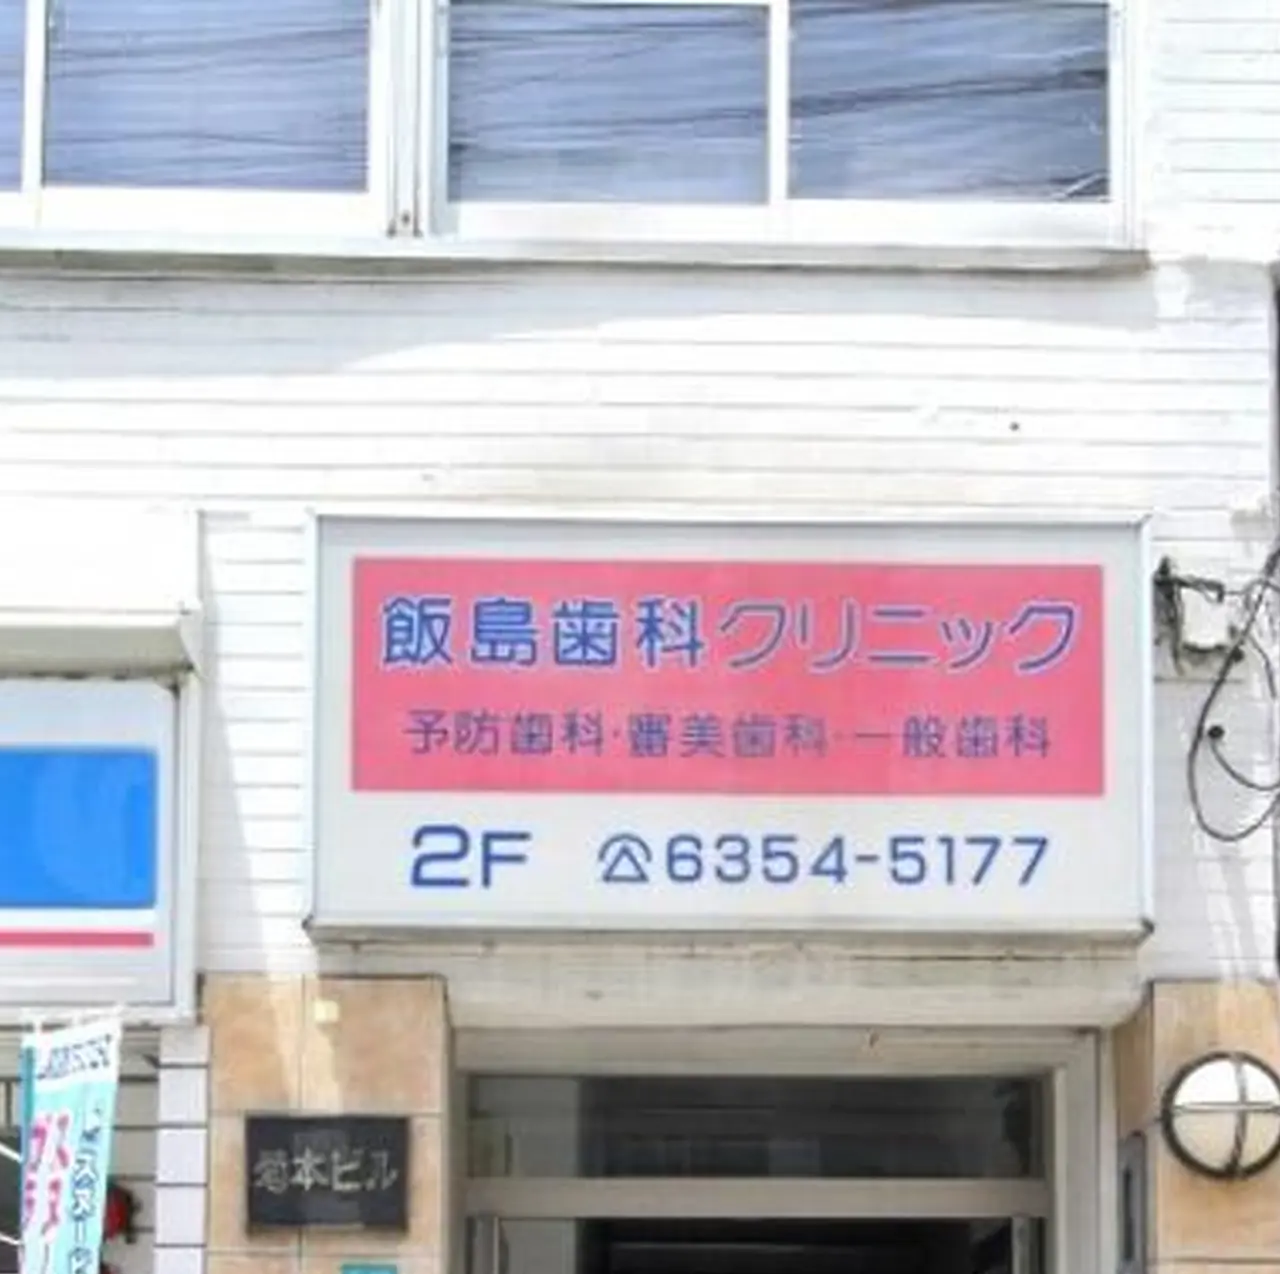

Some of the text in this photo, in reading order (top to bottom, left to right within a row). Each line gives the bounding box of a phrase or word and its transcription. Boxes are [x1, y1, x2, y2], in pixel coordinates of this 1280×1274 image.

[381, 597, 1079, 672] 飯島歯科クリニック
[412, 826, 1049, 887] 2F 6354-5177
